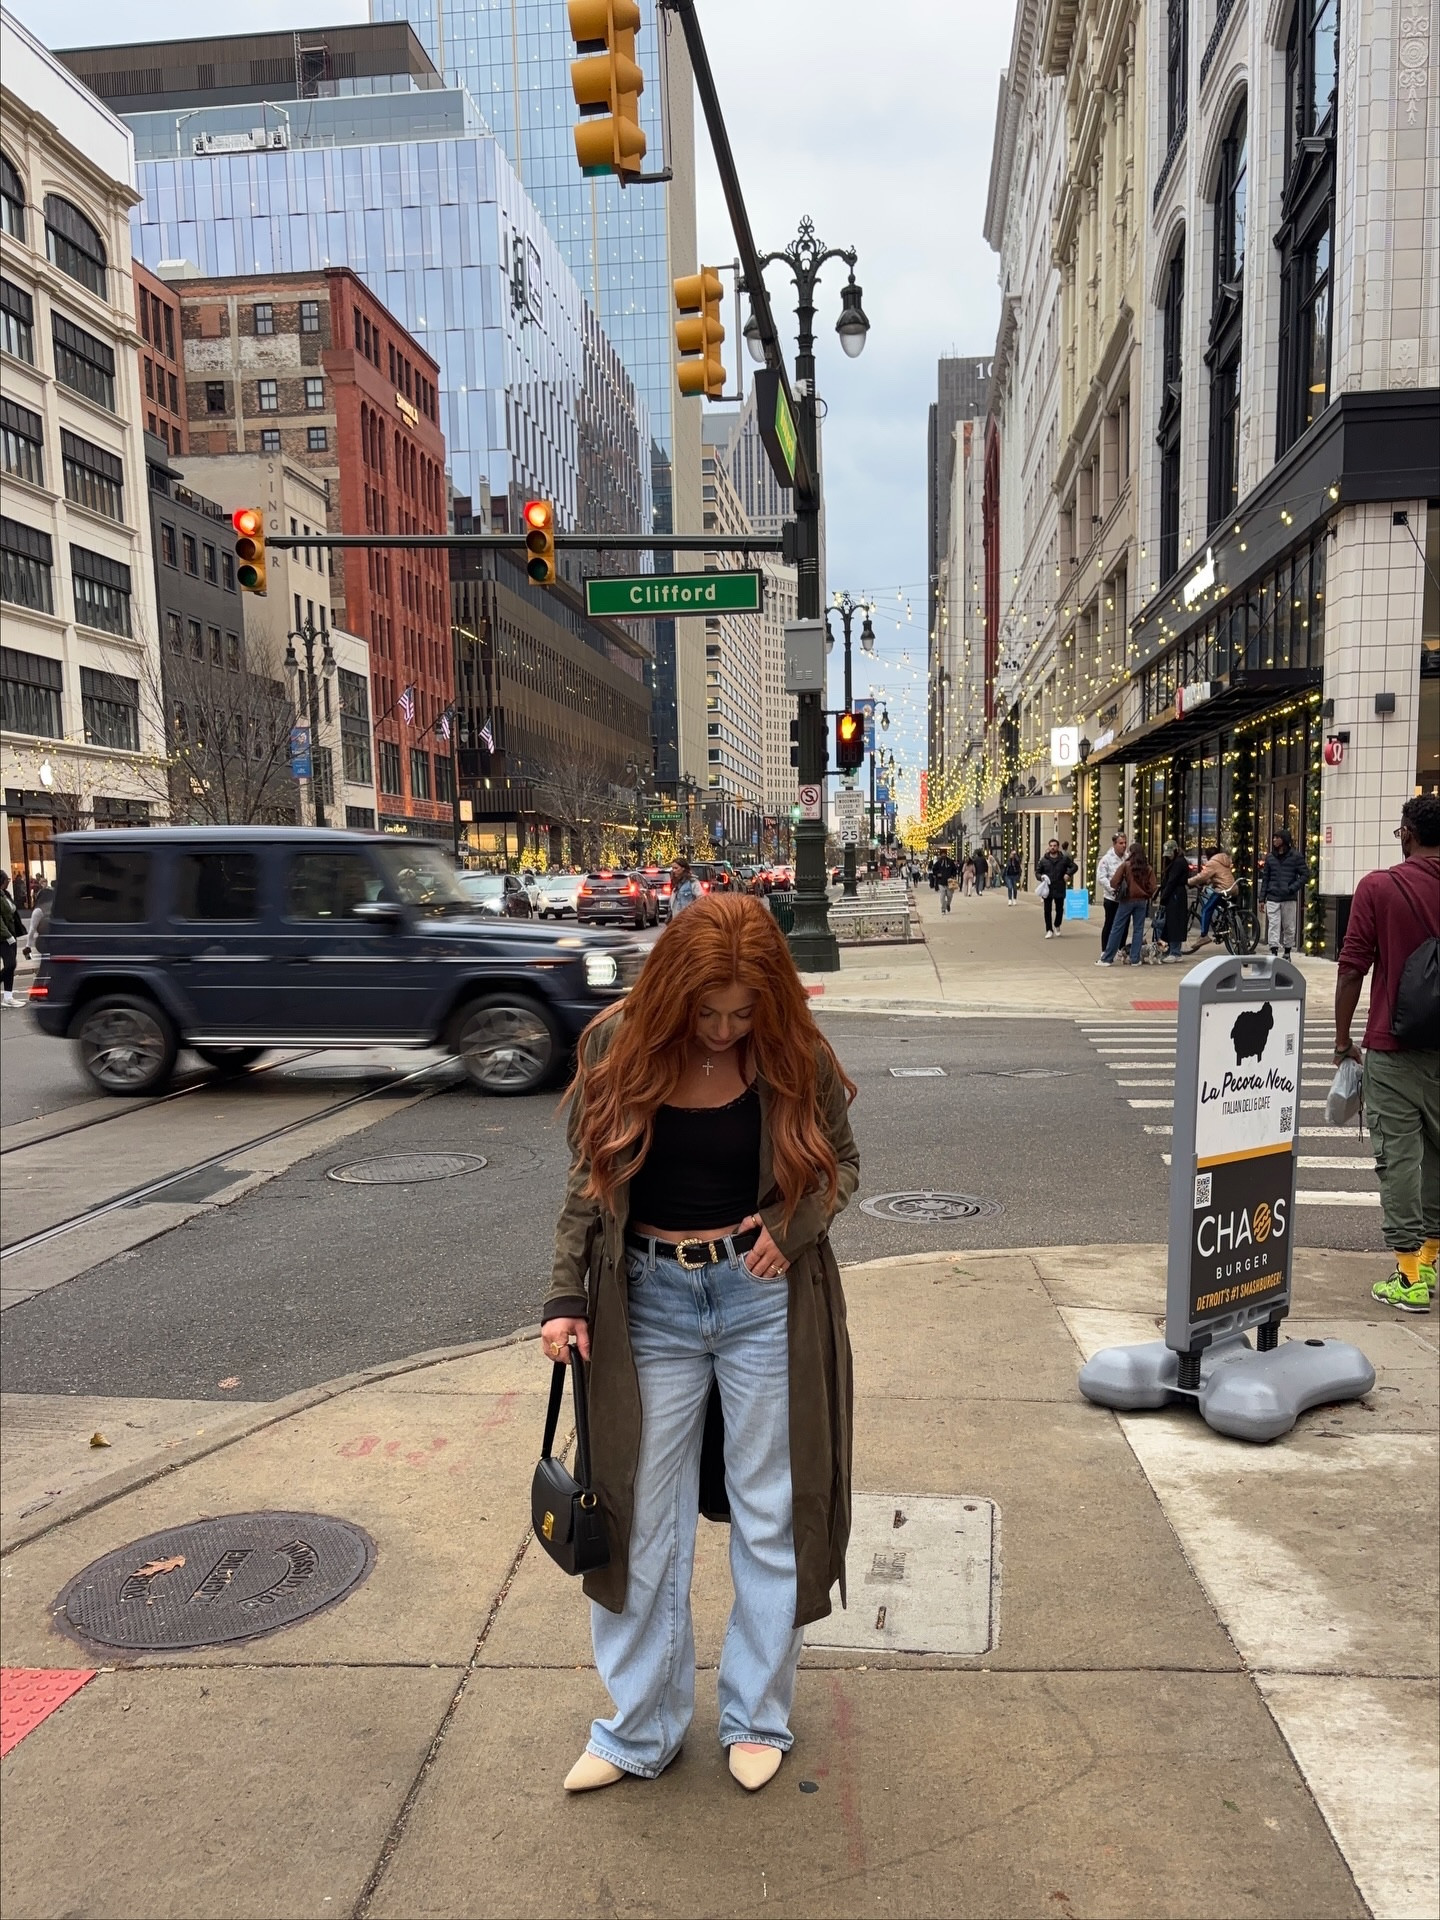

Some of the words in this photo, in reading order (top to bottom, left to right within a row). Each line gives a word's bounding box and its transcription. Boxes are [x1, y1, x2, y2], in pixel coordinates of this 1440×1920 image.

[267, 462, 280, 568] SINGR
[629, 583, 717, 604] Clifford
[1059, 733, 1070, 760] 6
[841, 830, 858, 841] 25
[1201, 1081, 1221, 1104] La
[1221, 1071, 1265, 1098] Pecora
[1265, 1067, 1295, 1093] Nera
[1222, 1100, 1242, 1115] ITALIAN
[1242, 1099, 1253, 1113] DELI
[1253, 1098, 1259, 1111] &
[1258, 1096, 1271, 1110] CAFE
[1197, 1198, 1286, 1258] CHAOS
[1216, 1253, 1268, 1280] BURGER
[1196, 1287, 1230, 1312] DETROIT'S
[1230, 1285, 1240, 1301] #1
[1240, 1271, 1282, 1298] SMASHBURGER!
